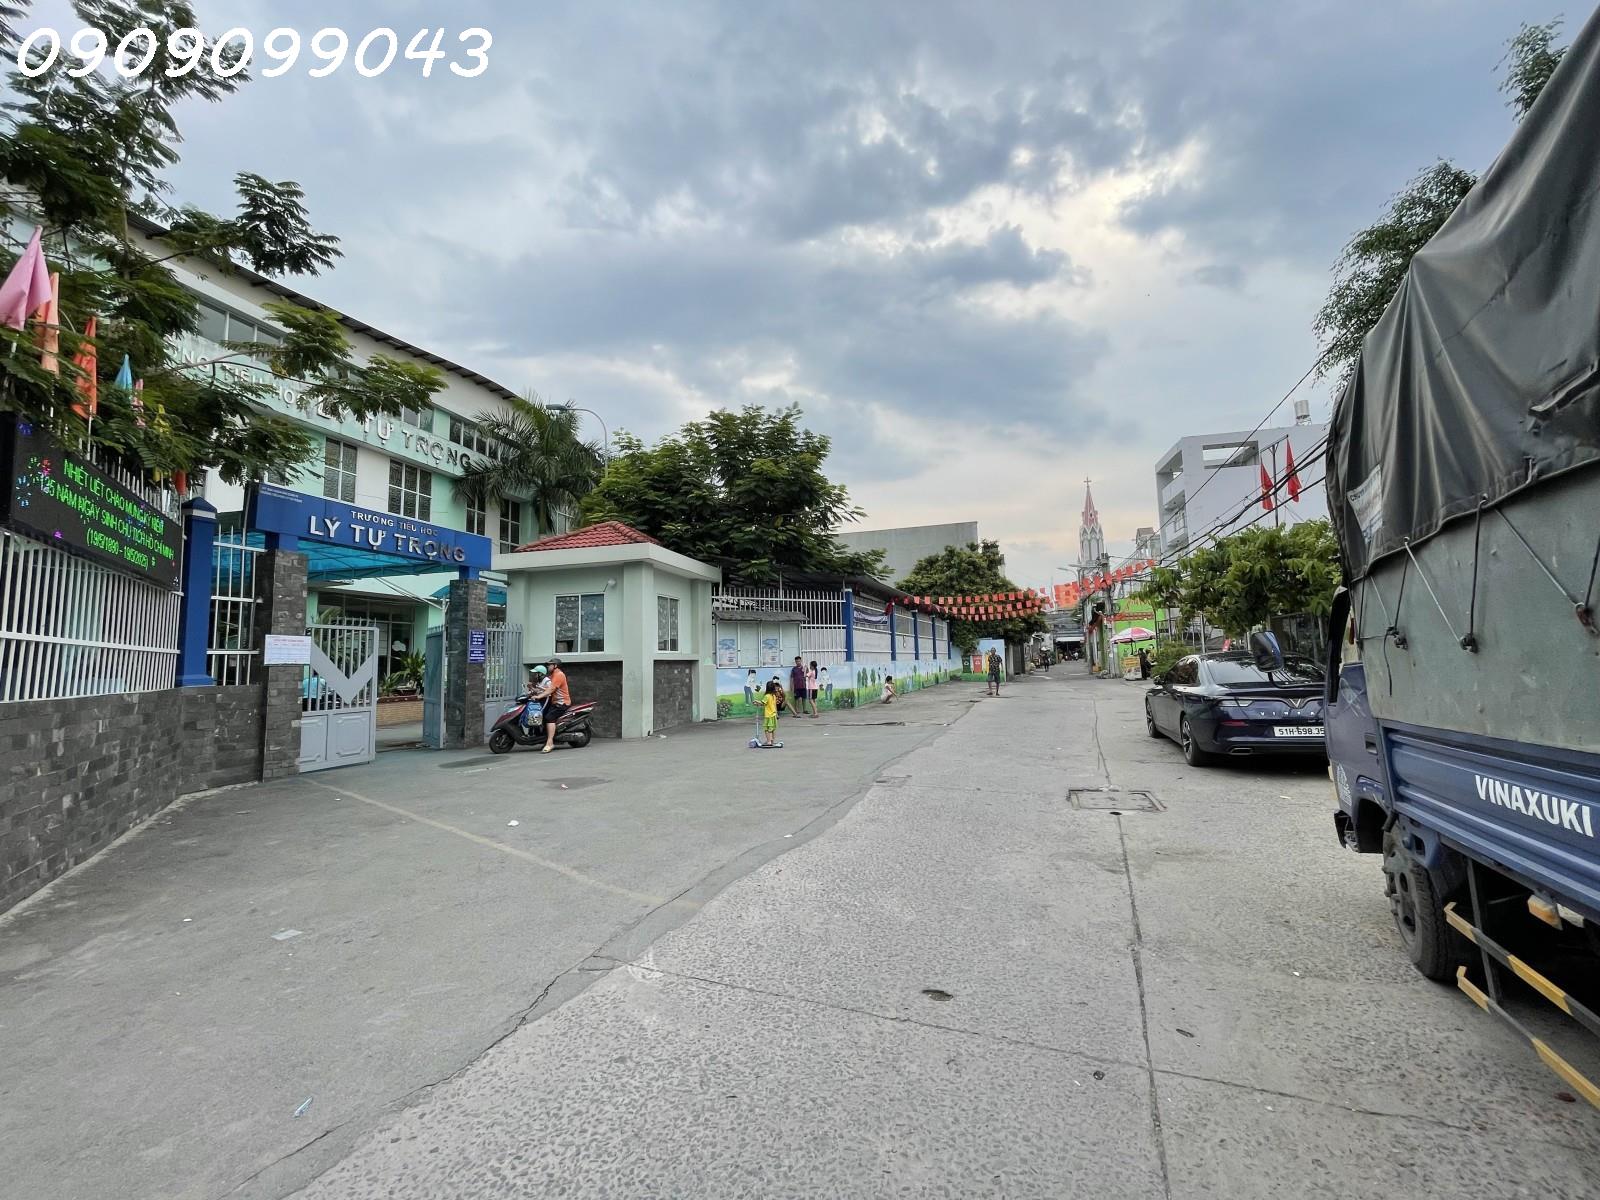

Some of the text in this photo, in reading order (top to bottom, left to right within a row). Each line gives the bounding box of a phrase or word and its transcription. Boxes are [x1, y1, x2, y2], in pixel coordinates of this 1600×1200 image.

[401, 429, 472, 471] TRỌNG
[350, 524, 387, 550] TỰ
[393, 533, 465, 562] TRỌNG
[1474, 774, 1595, 838] VINAXUKI
